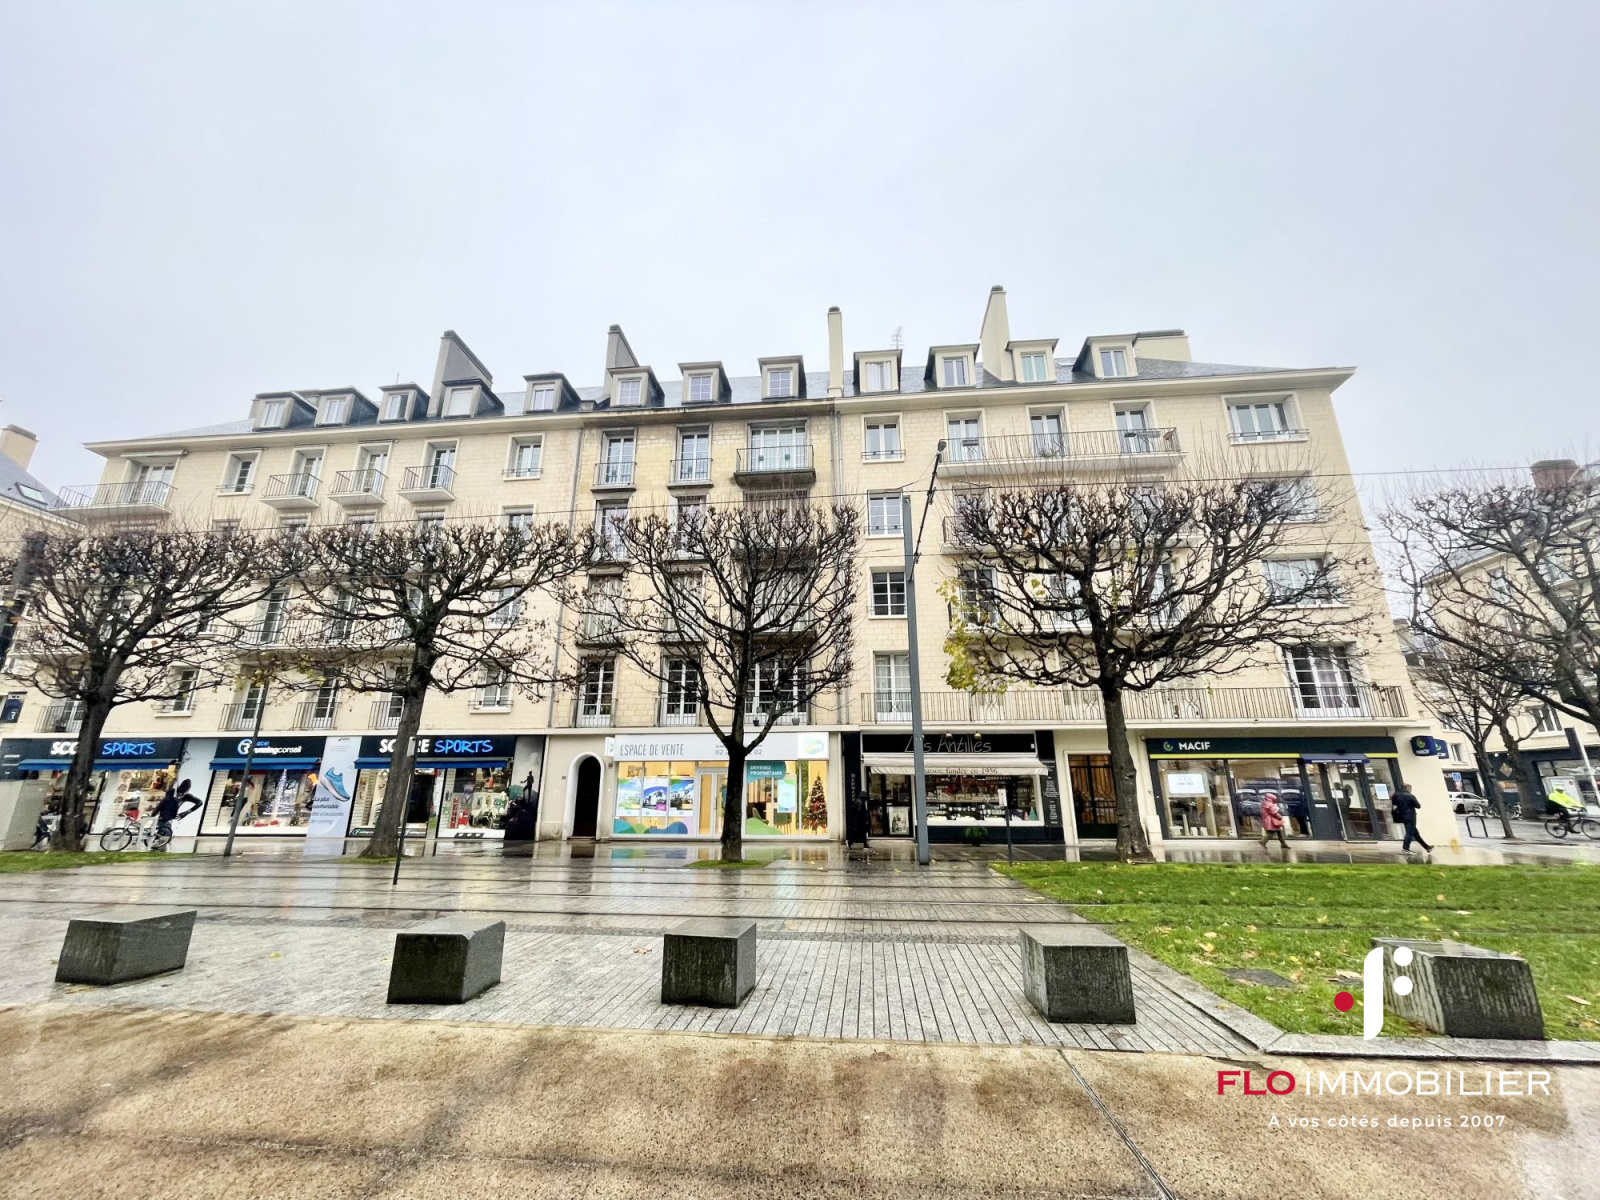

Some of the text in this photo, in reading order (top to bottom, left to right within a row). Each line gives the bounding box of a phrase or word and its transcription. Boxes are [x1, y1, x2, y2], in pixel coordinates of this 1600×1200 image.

[102, 742, 156, 756] SPORTS
[434, 739, 494, 754] SPORTS
[620, 743, 684, 756] ESPACE DE VENTE
[937, 733, 992, 753] Antilles
[1178, 741, 1211, 750] MACIF
